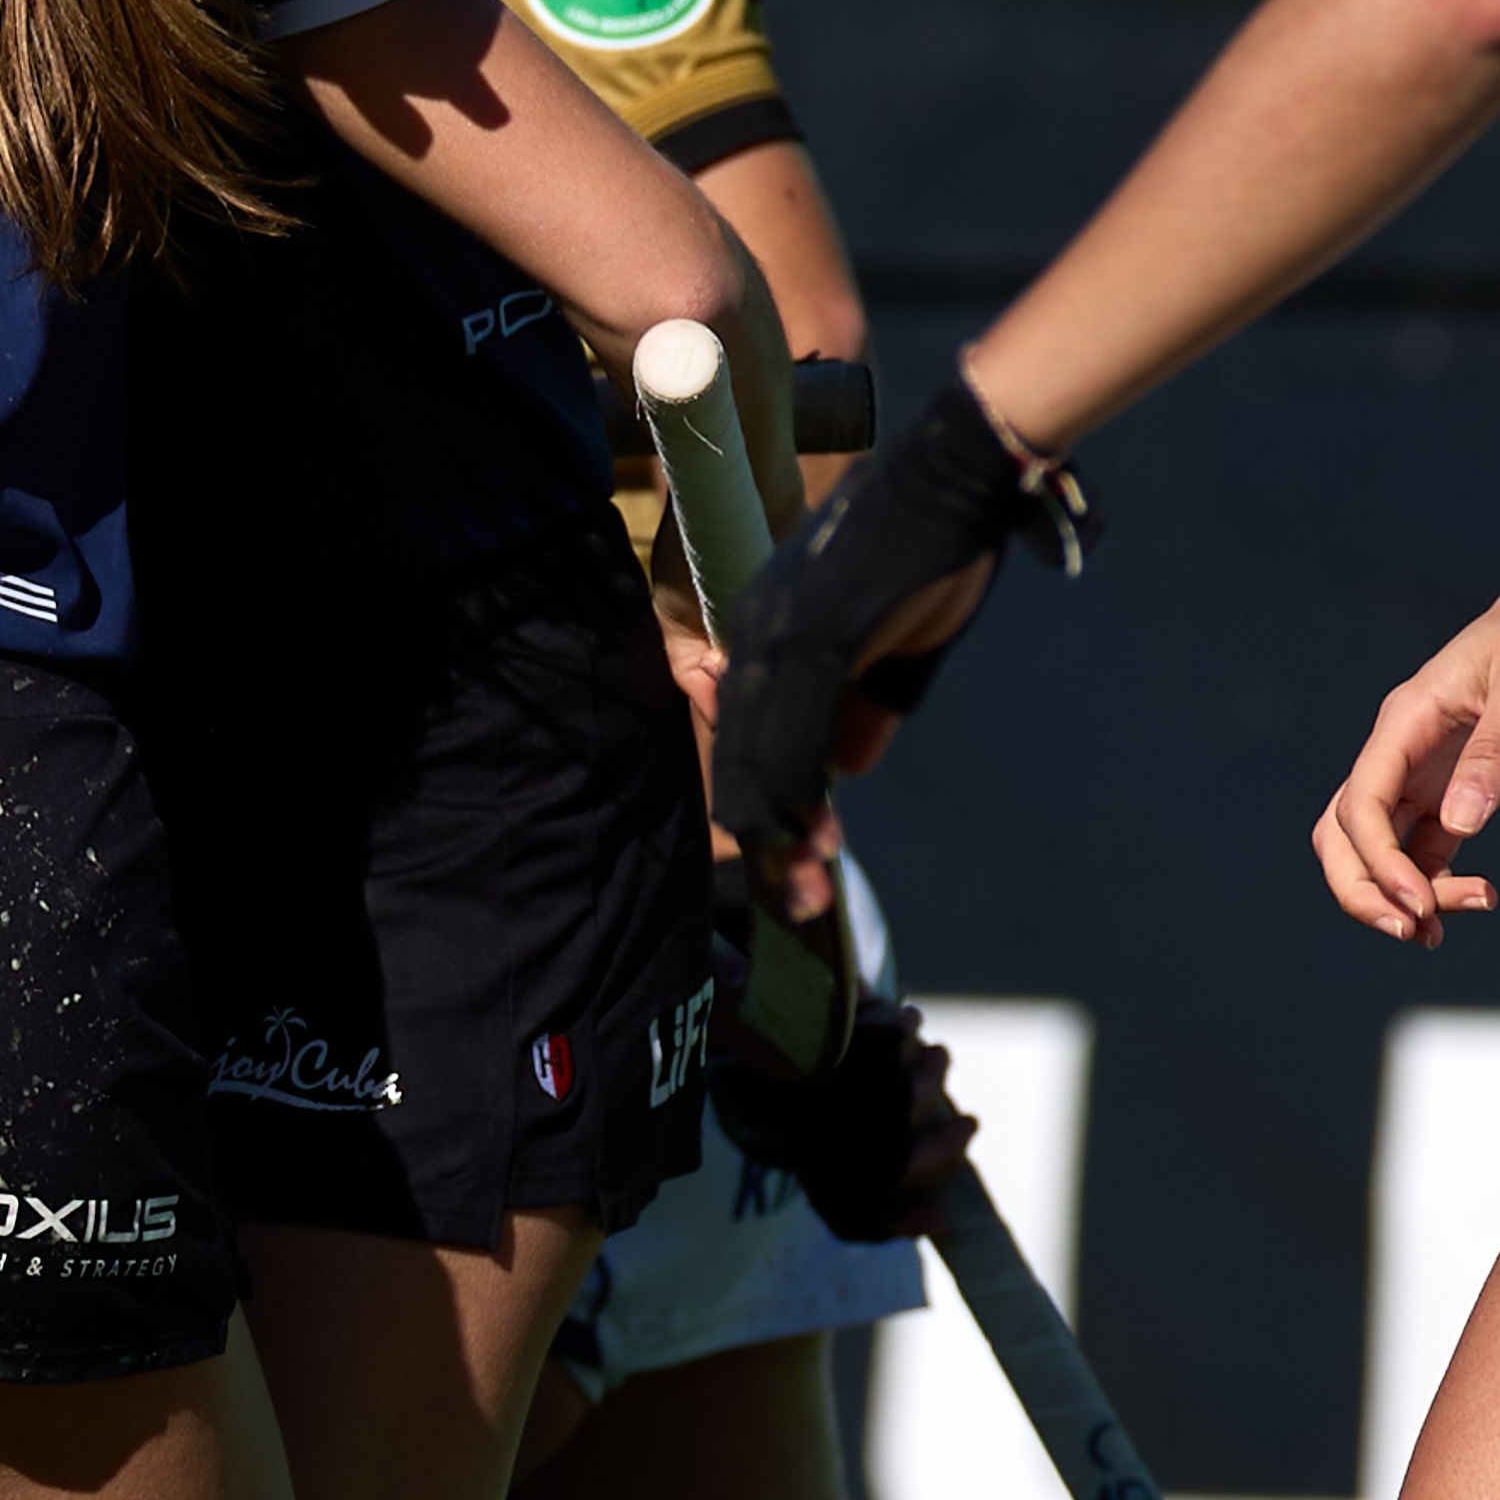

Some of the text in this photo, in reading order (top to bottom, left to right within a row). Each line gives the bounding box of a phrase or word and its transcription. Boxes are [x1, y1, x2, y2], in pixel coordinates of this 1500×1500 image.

[290, 1039, 403, 1105] Cuba
[26, 1256, 43, 1277] &
[59, 1254, 178, 1278] STRATEGY
